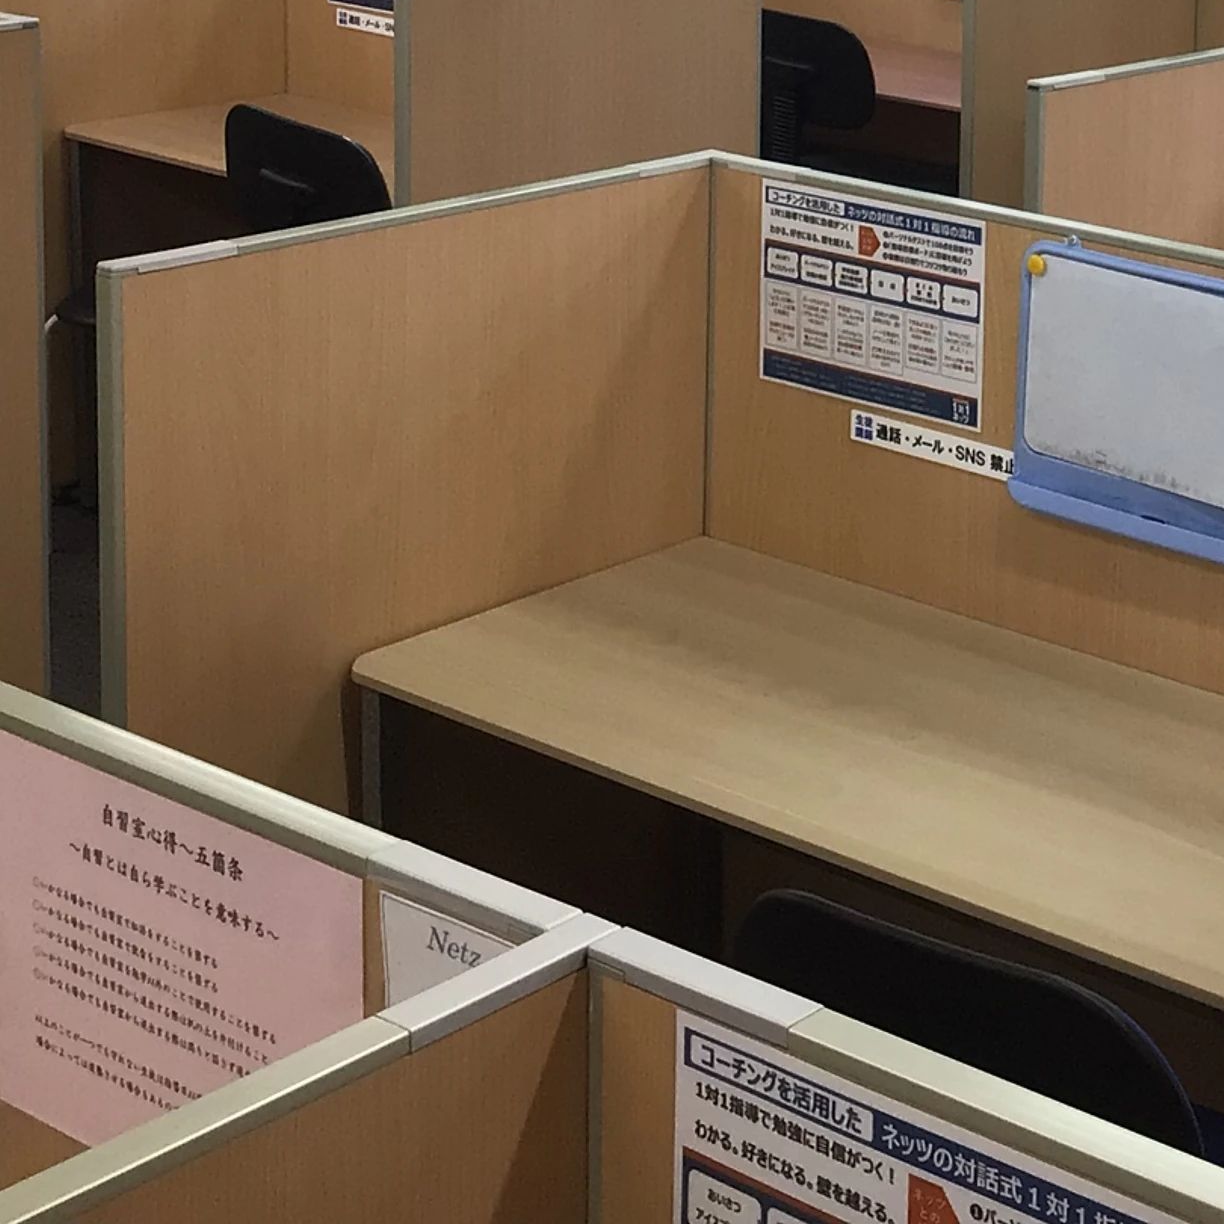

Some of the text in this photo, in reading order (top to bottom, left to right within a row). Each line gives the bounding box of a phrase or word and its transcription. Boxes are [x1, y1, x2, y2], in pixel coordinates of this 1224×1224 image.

[875, 423, 986, 468] 通話・メール・SNS
[101, 803, 244, 883] 自習室心得～五箇条
[68, 841, 280, 941] ～自習とは自ら学ぶことを意味する～
[426, 925, 484, 968] Netz
[699, 1042, 865, 1137] コーチングを活用した
[693, 1118, 896, 1224] わかる。好きになる。壁を越える。
[707, 1188, 742, 1214] あいさつ
